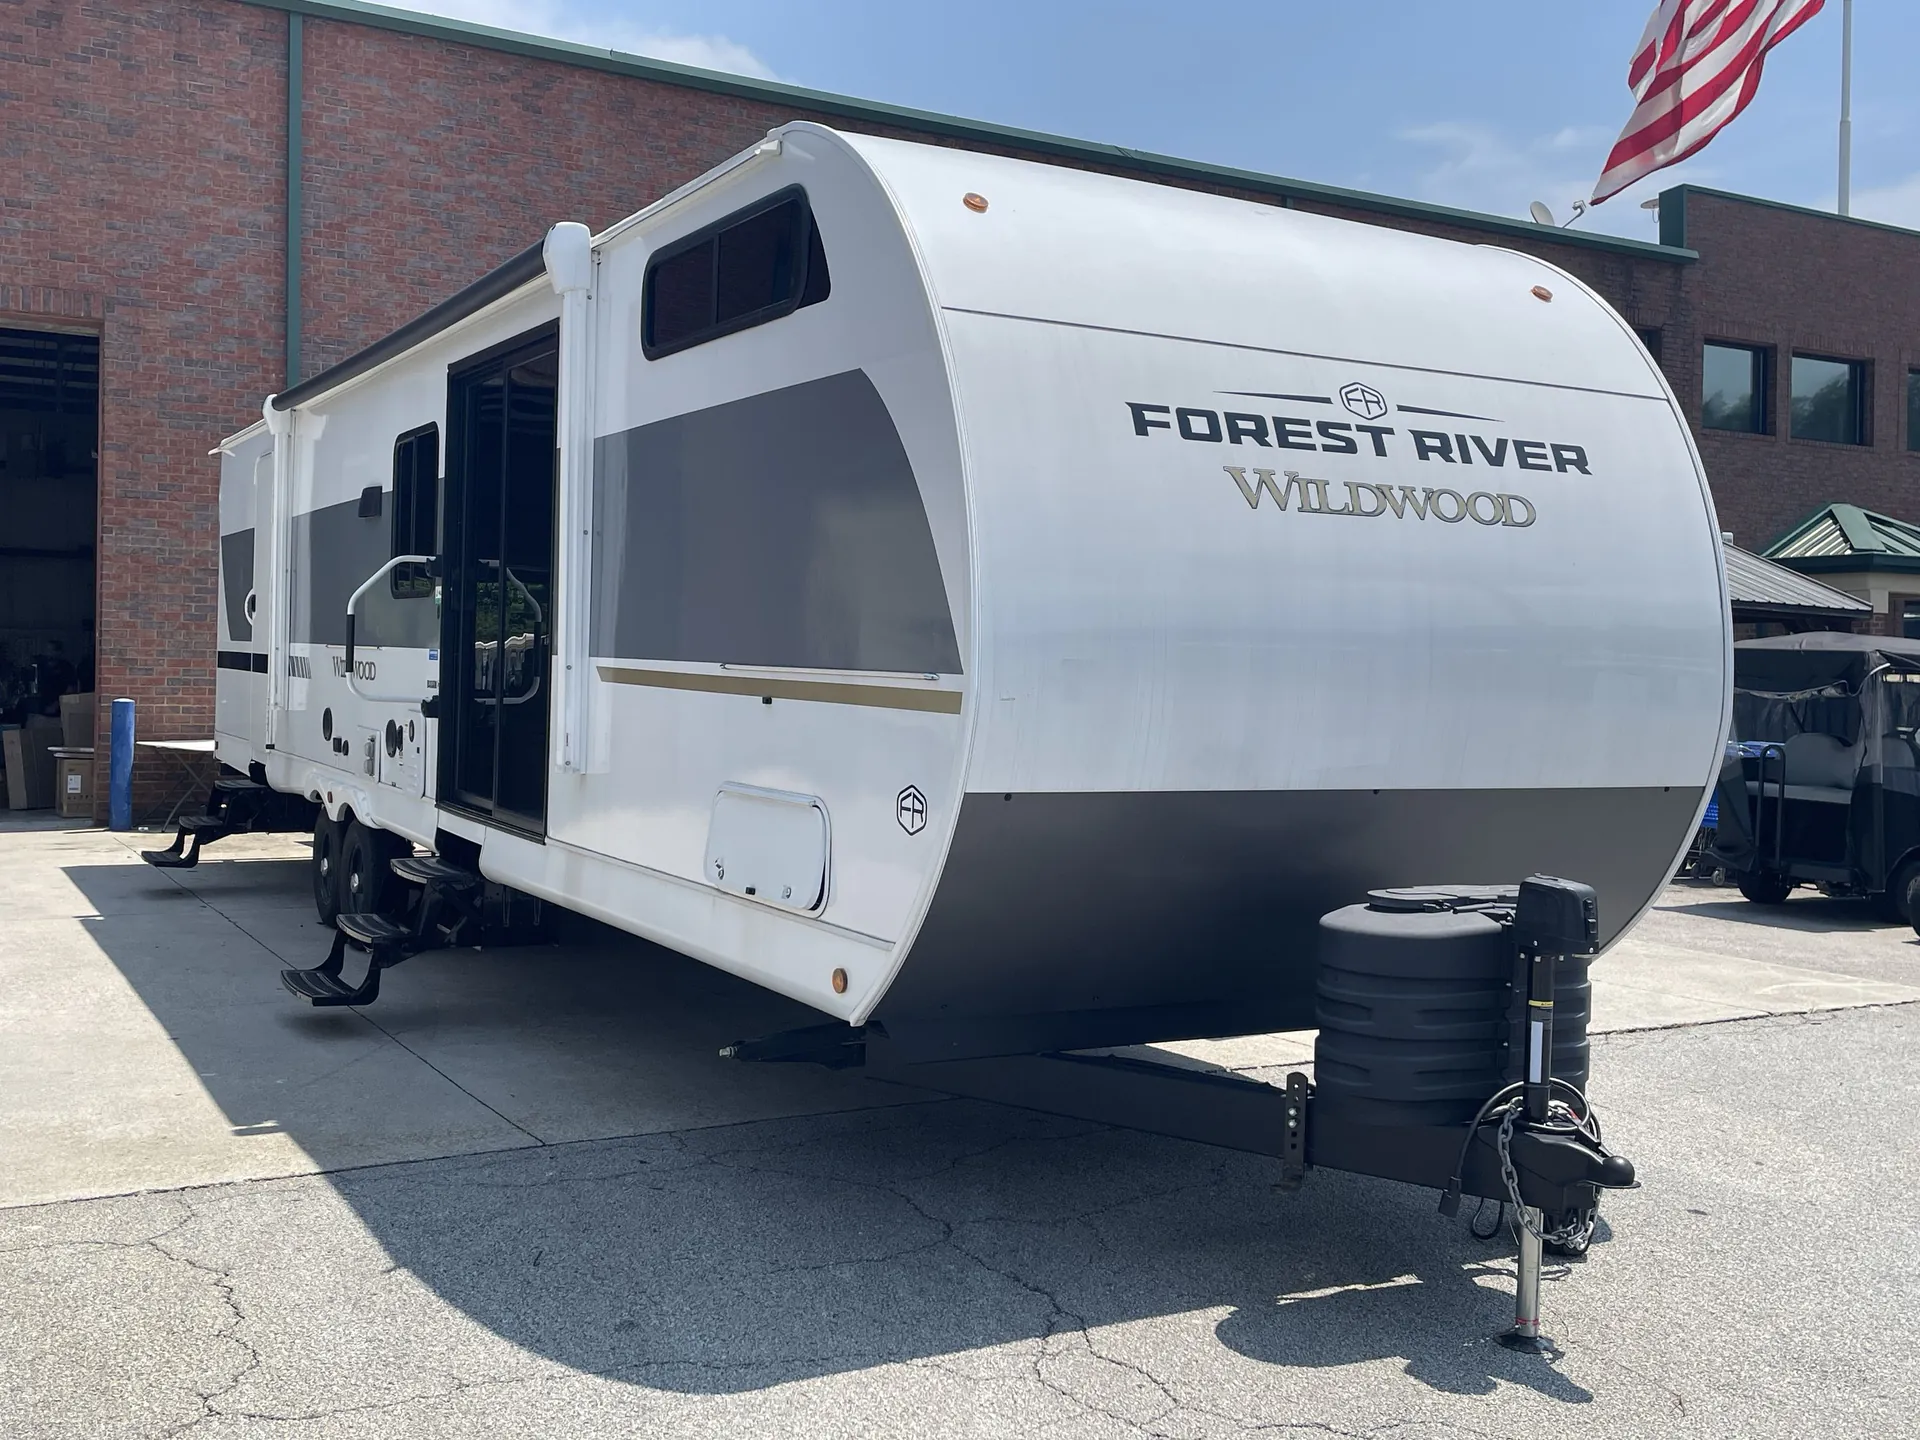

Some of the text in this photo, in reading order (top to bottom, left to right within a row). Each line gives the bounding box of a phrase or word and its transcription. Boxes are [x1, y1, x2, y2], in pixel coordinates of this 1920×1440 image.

[1125, 401, 1592, 475] FOREST RIVER
[1223, 466, 1537, 528] WILDWOOD
[332, 655, 376, 680] WIWOOD
